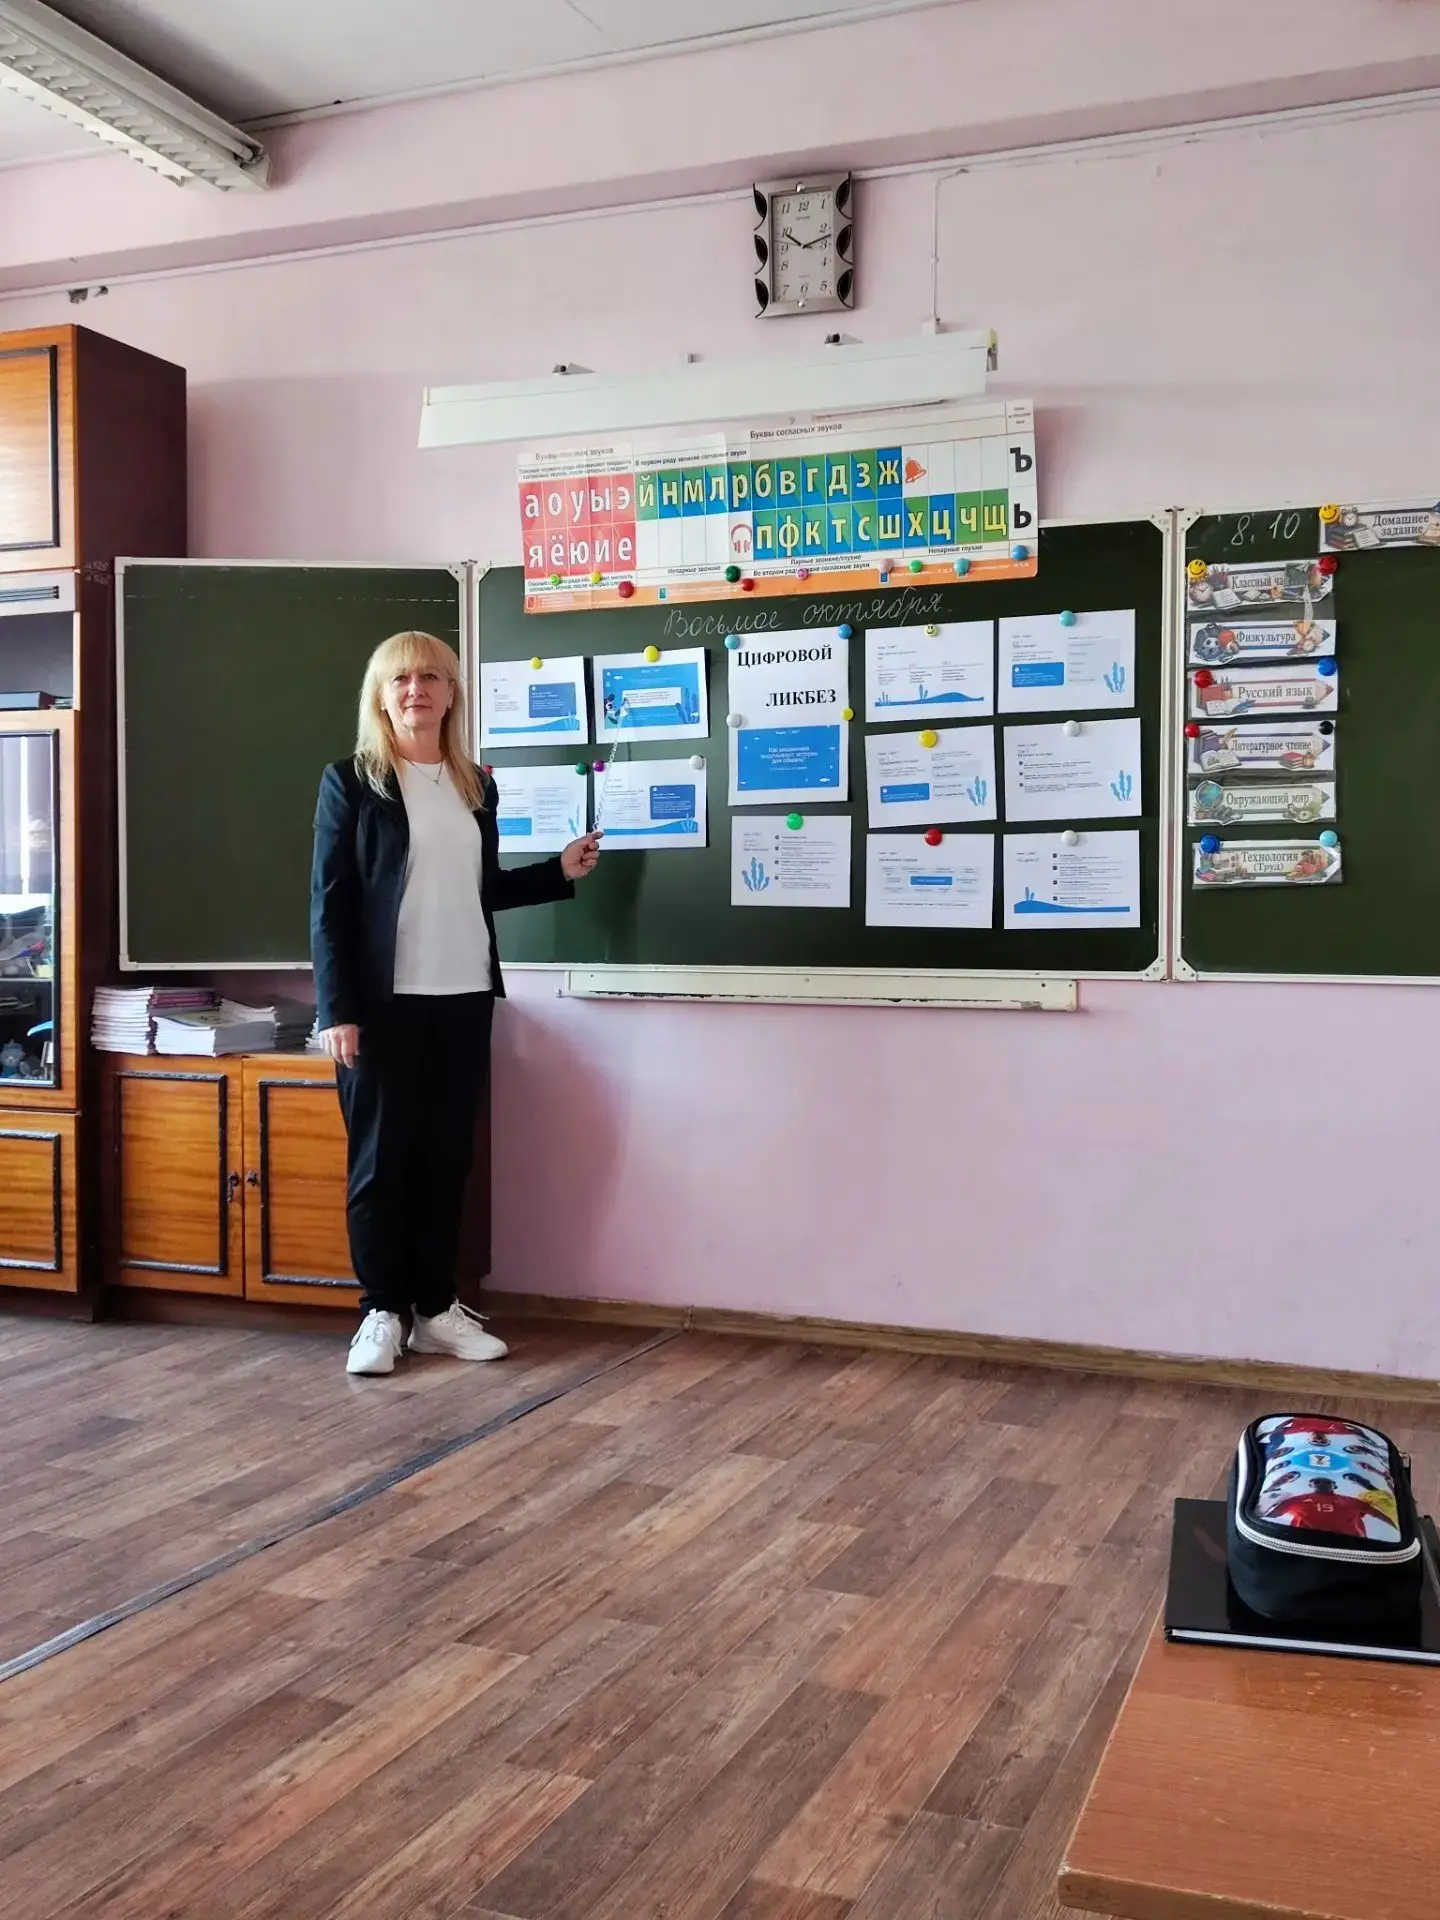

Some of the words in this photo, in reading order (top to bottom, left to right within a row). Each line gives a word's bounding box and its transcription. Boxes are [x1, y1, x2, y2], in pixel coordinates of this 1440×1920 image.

[782, 204, 791, 214] 11
[799, 201, 810, 212] 12
[820, 199, 826, 208] 1
[782, 228, 792, 238] 10
[819, 223, 828, 233] 2
[781, 244, 788, 255] 9
[820, 240, 827, 249] 3
[781, 260, 788, 271] 8
[822, 258, 828, 267] 4
[783, 285, 790, 295] 7
[801, 283, 808, 293] 6
[819, 281, 828, 291] 5
[750, 430, 774, 440] Буквы
[775, 426, 815, 437] согласных
[817, 423, 843, 433] звуков
[1372, 515, 1430, 528] Домашнее
[1381, 525, 1424, 537] задание
[928, 545, 960, 554] Непарные
[1231, 574, 1271, 589] Классный
[664, 608, 784, 638] Восьмое
[1236, 630, 1296, 644] Физкультура
[737, 644, 833, 669] ЦИФРОВОЙ
[766, 688, 837, 708] ЛИКБЕЗ
[1238, 686, 1283, 700] Русский
[1285, 687, 1313, 698] язык
[1231, 740, 1283, 756] Литературное
[1285, 741, 1312, 751] чтение
[1226, 791, 1289, 807] Окружающий
[1291, 794, 1310, 805] мир
[1241, 852, 1299, 864] Технология
[1253, 862, 1284, 873] (Труд)
[1315, 1503, 1334, 1514] 19
